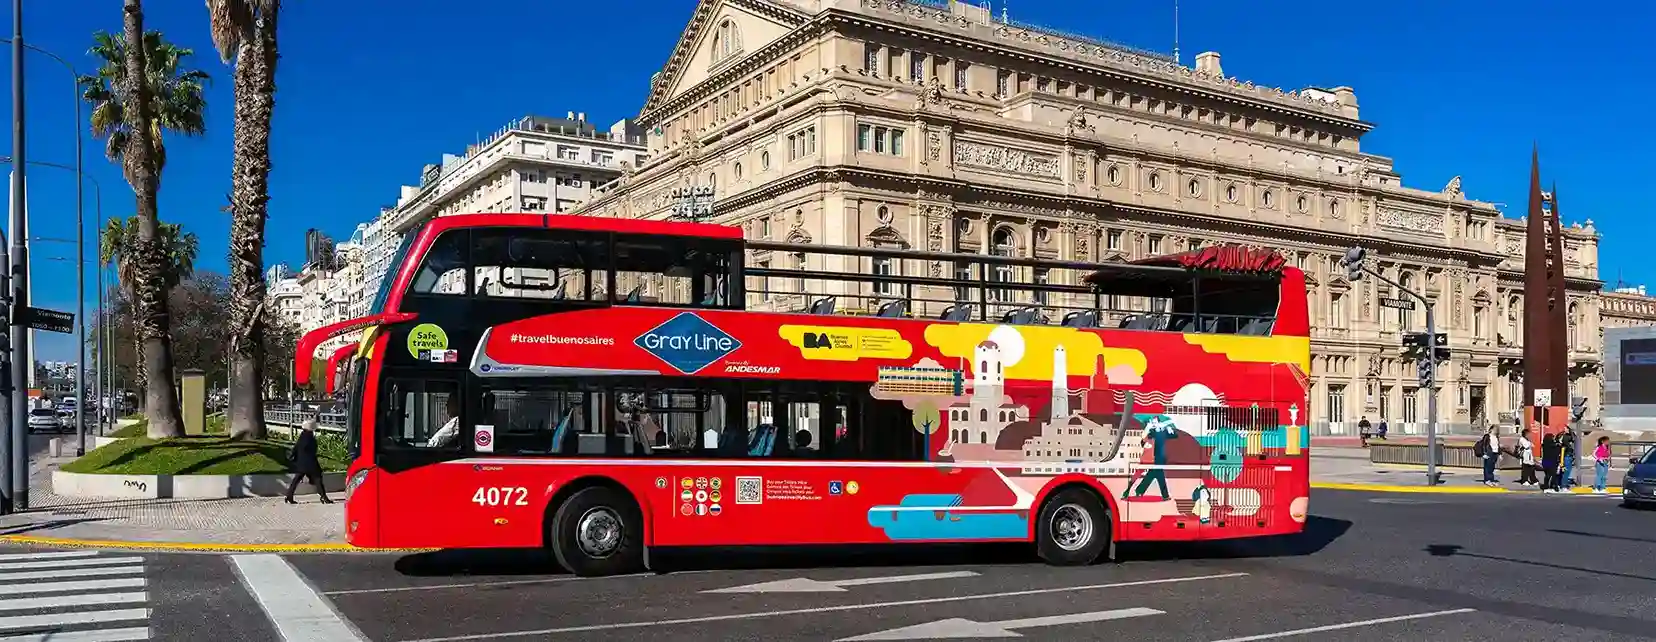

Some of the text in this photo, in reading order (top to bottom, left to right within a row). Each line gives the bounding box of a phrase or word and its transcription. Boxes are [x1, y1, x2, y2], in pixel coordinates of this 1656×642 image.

[417, 332, 437, 340] Safe
[510, 333, 615, 346] #travelbuenosaires
[644, 333, 733, 351] Gray Line
[803, 332, 832, 349] BA
[412, 339, 444, 348] travels
[724, 365, 781, 374] ANDESMAR
[472, 486, 528, 506] 4072
